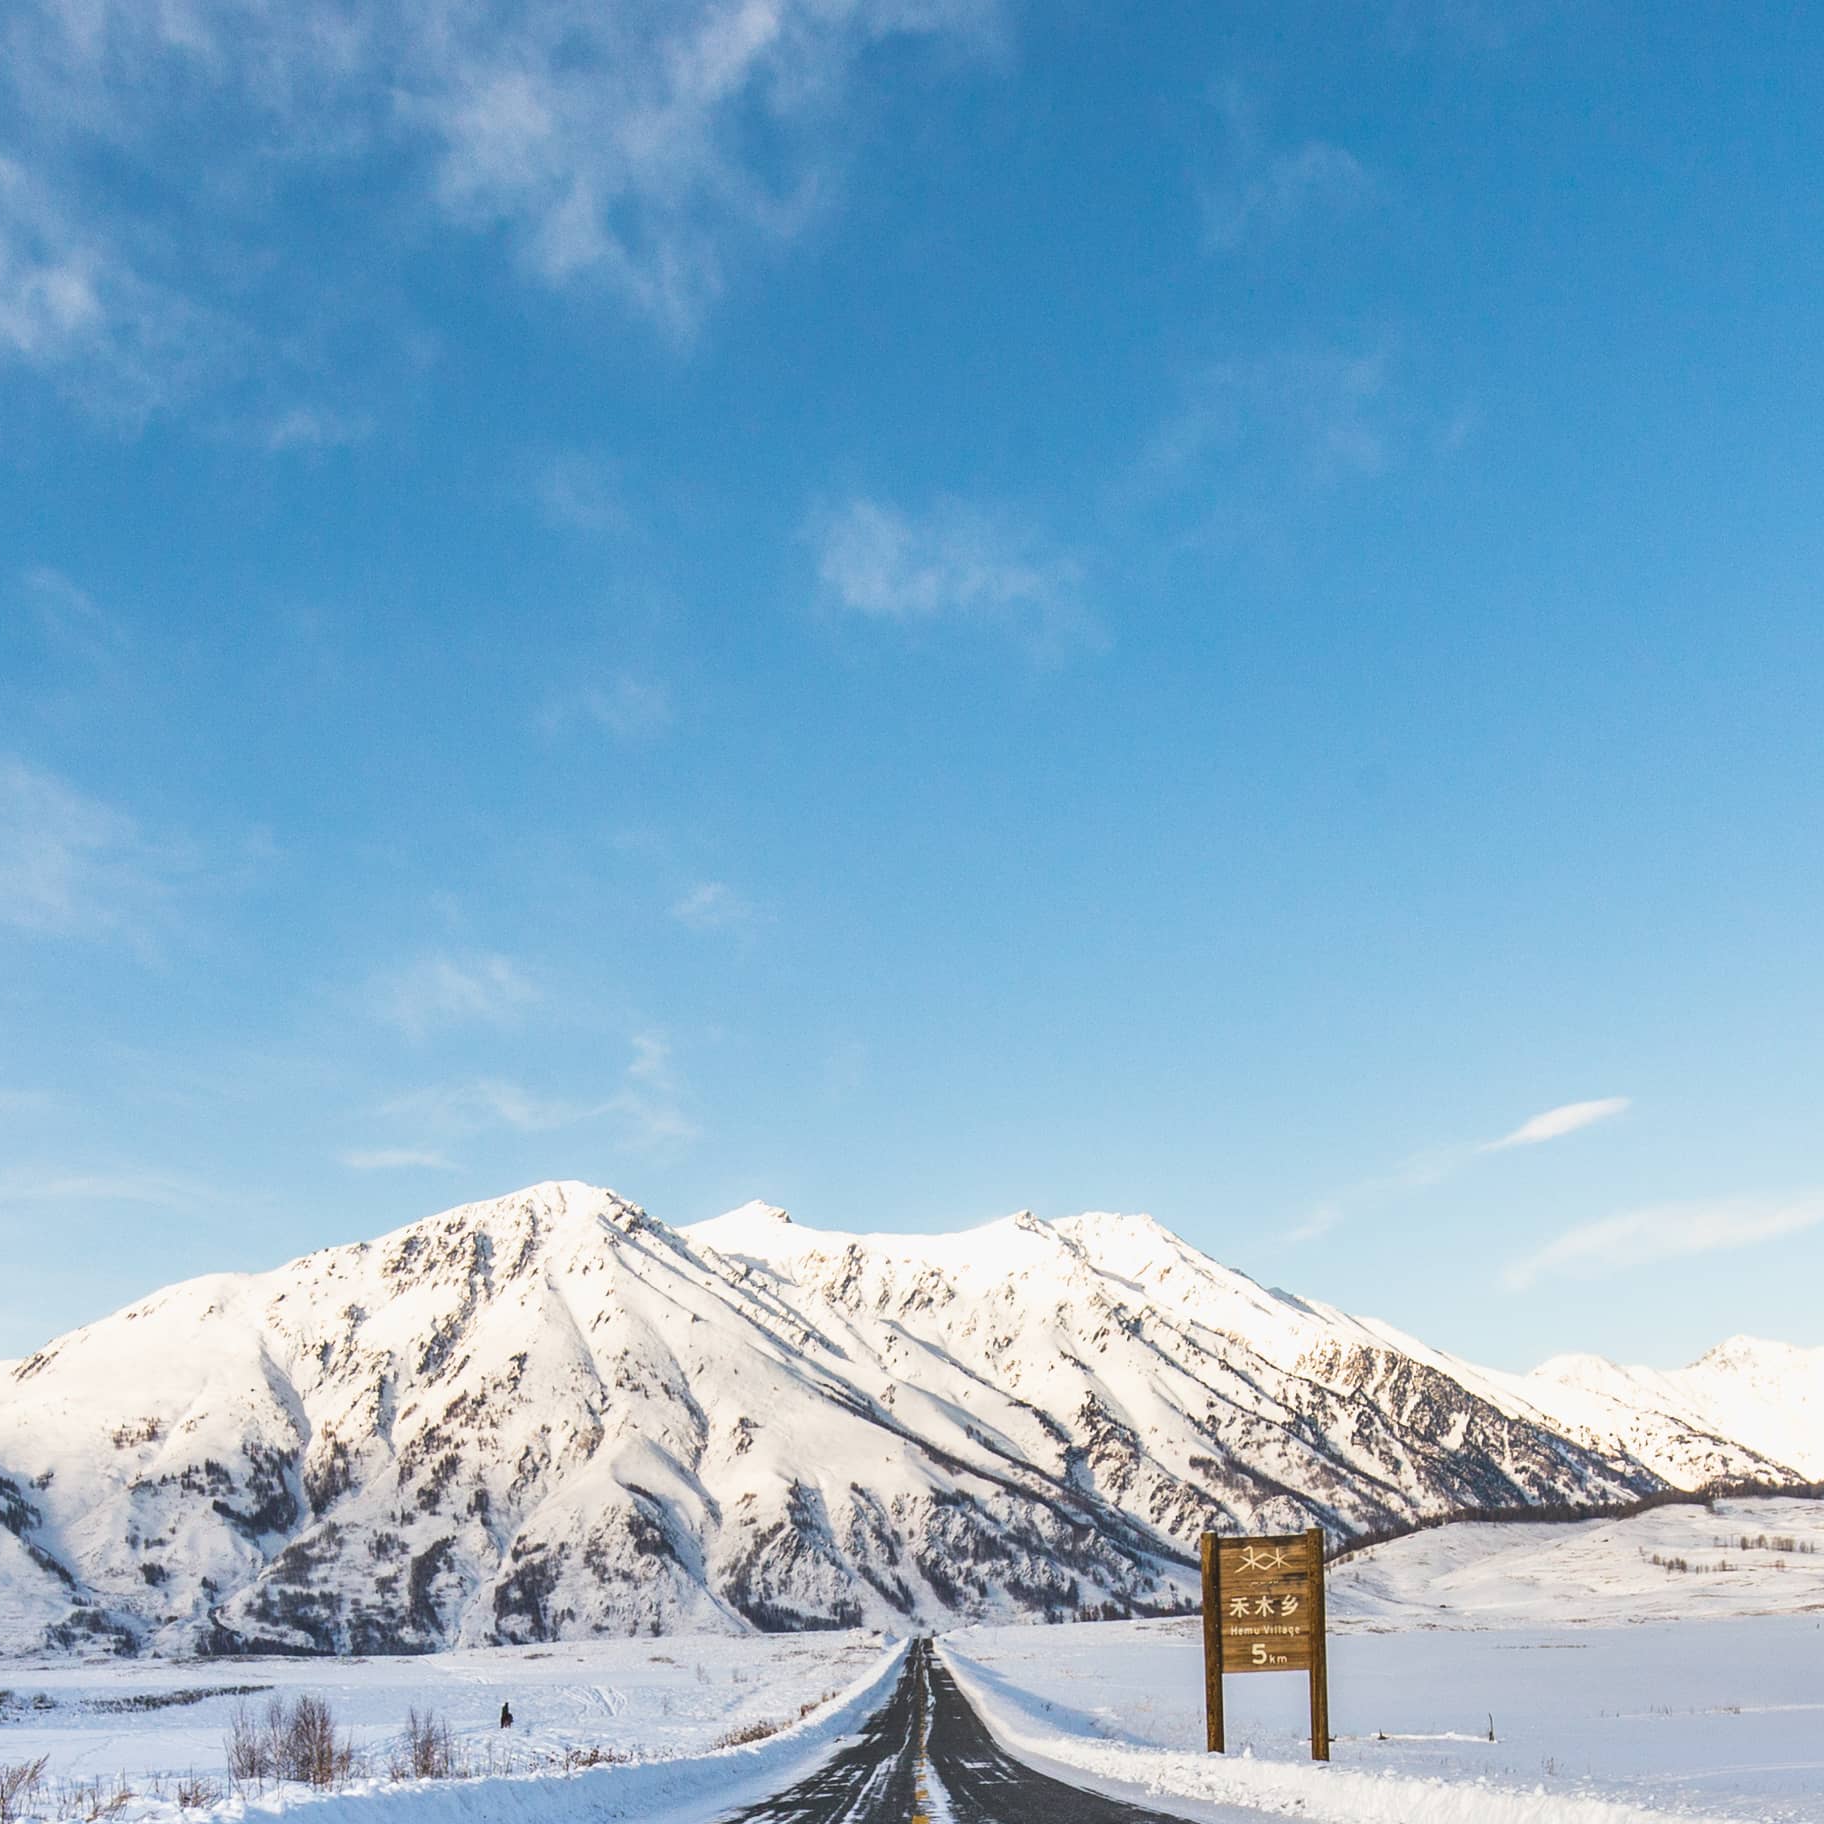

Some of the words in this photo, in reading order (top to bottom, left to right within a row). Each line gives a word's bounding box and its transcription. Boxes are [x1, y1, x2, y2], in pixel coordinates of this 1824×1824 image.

[1229, 1594, 1299, 1618] 禾木乡
[1230, 1625, 1260, 1636] Hemu
[1263, 1625, 1301, 1638] Village
